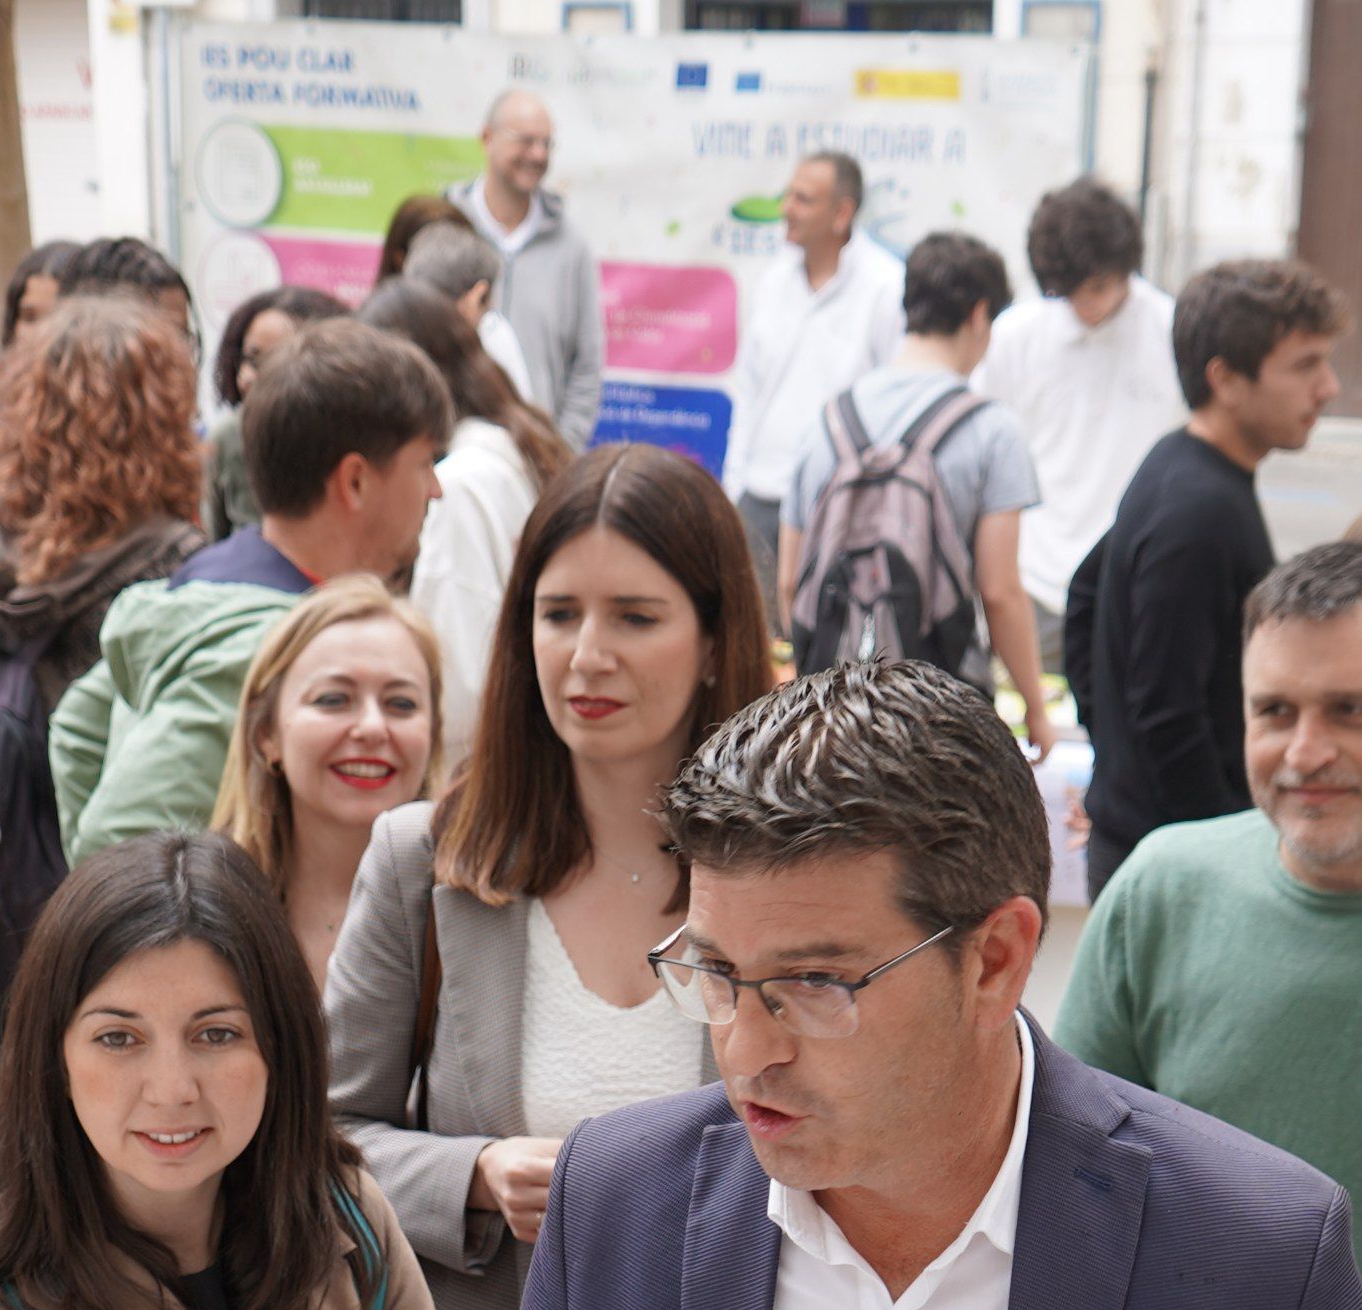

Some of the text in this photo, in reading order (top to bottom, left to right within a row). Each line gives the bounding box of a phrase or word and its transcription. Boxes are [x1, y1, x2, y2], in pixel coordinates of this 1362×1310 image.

[201, 44, 354, 73] IES POU CLAR
[203, 77, 421, 111] OFERTA FORMATIVA
[693, 121, 966, 163] VINE A ESTUDIAR A
